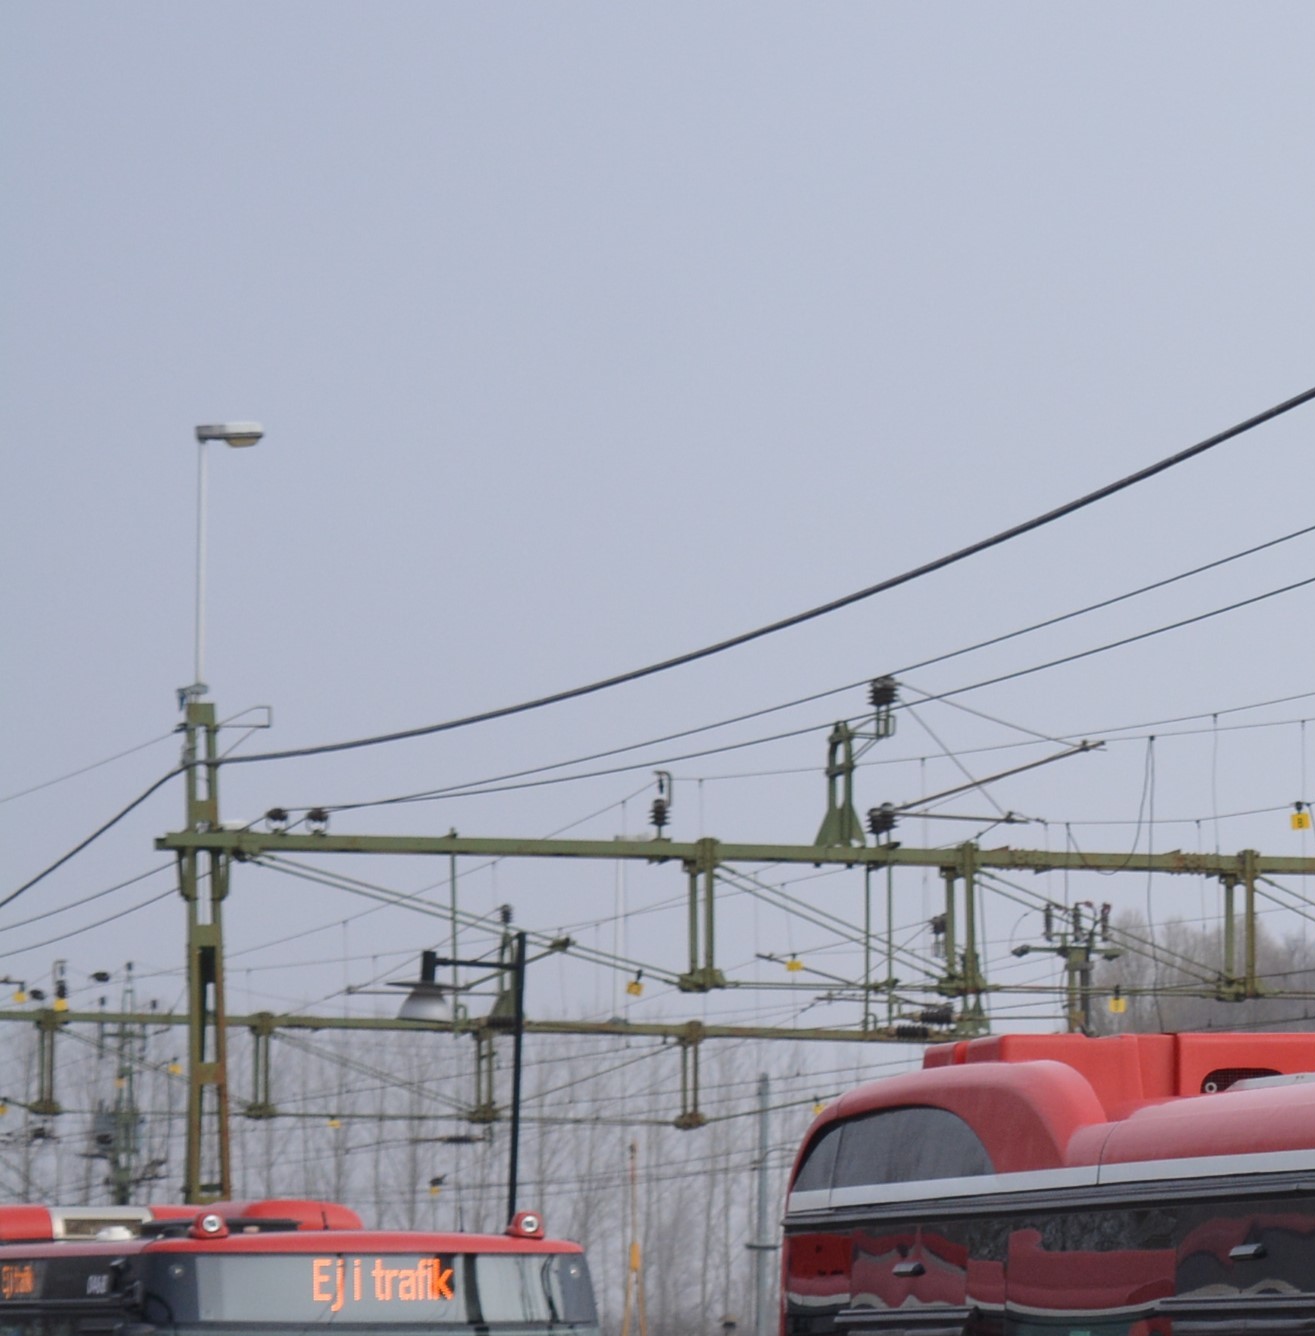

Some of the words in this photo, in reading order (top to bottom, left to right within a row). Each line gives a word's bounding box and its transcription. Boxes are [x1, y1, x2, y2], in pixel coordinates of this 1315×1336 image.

[312, 1258, 346, 1312] Ej
[353, 1258, 362, 1301] i
[372, 1258, 455, 1301] trafik
